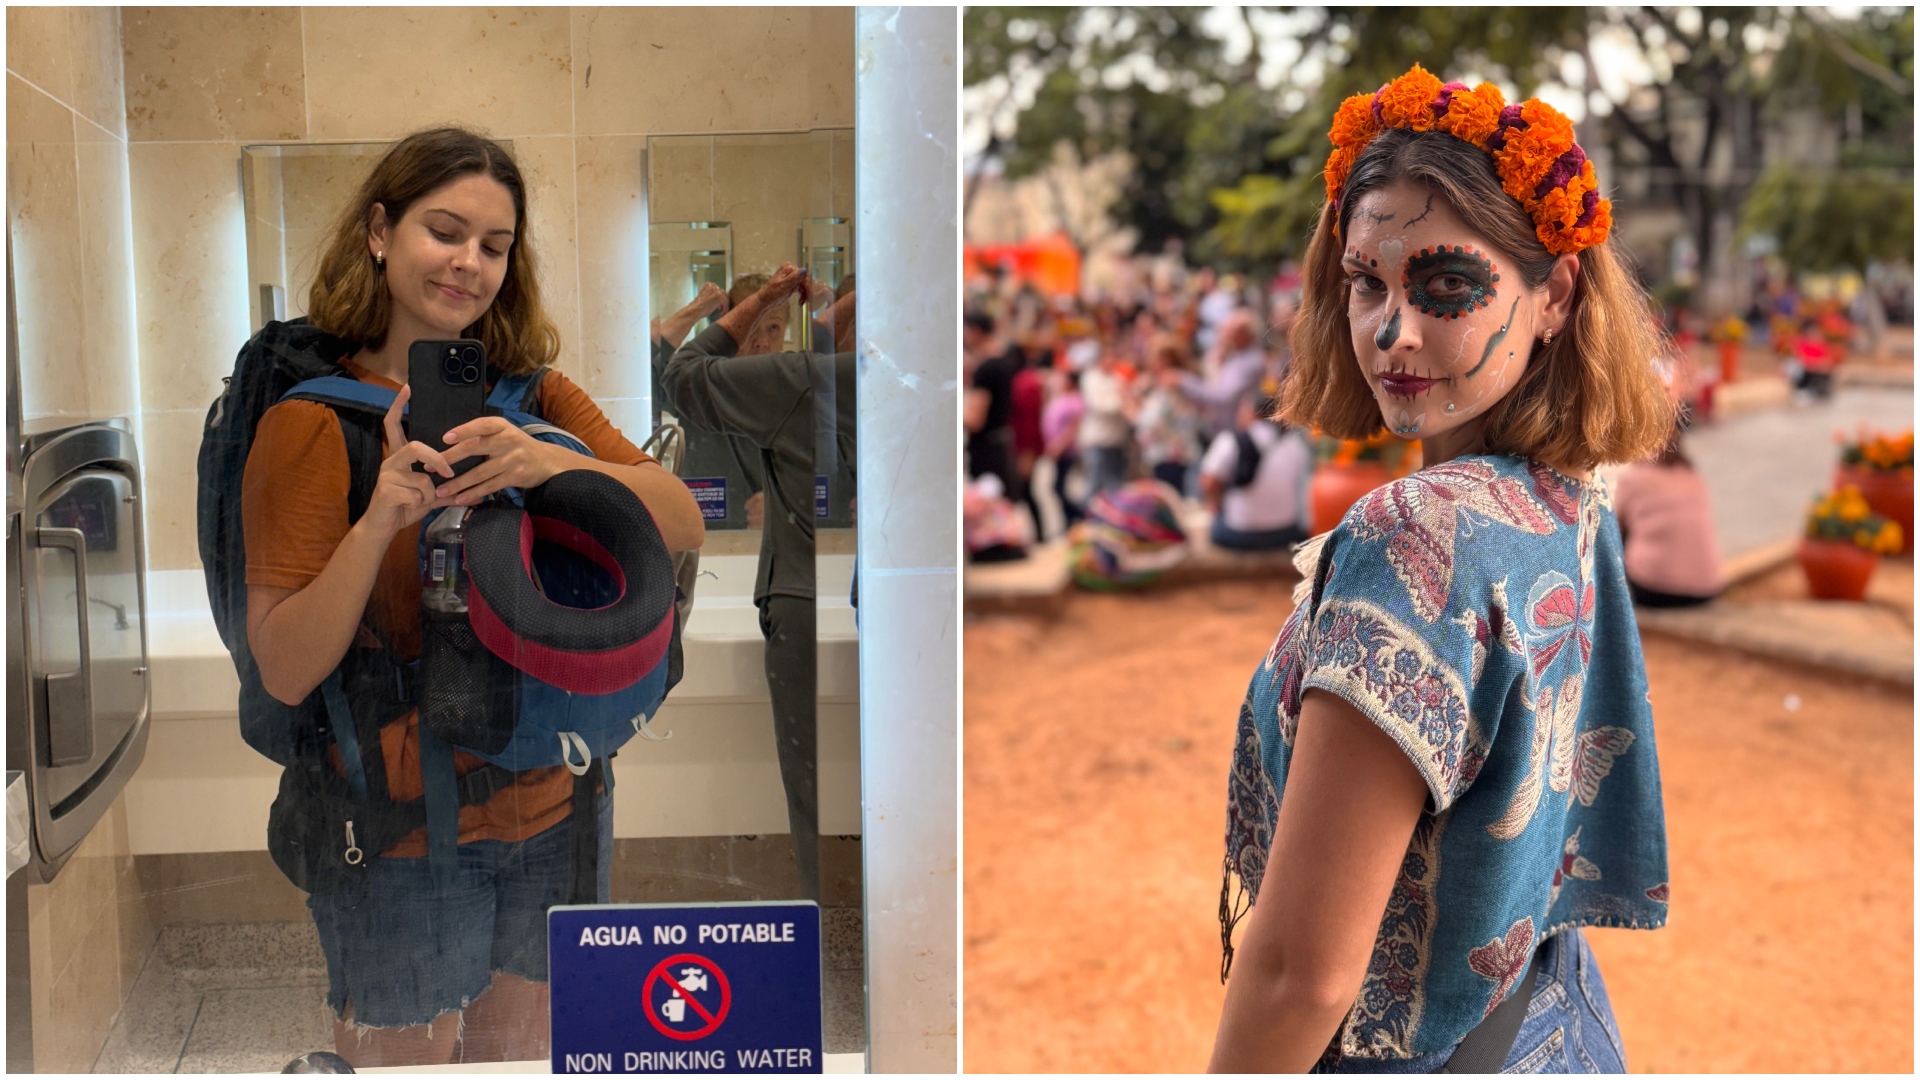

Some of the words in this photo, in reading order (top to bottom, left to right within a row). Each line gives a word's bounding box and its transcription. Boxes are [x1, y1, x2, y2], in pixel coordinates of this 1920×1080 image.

[580, 926, 642, 946] AGUA
[654, 925, 687, 944] NO
[699, 923, 794, 943] POTABLE
[566, 1053, 611, 1072] NON
[625, 1050, 724, 1071] DRINKING
[737, 1049, 811, 1068] WATER
